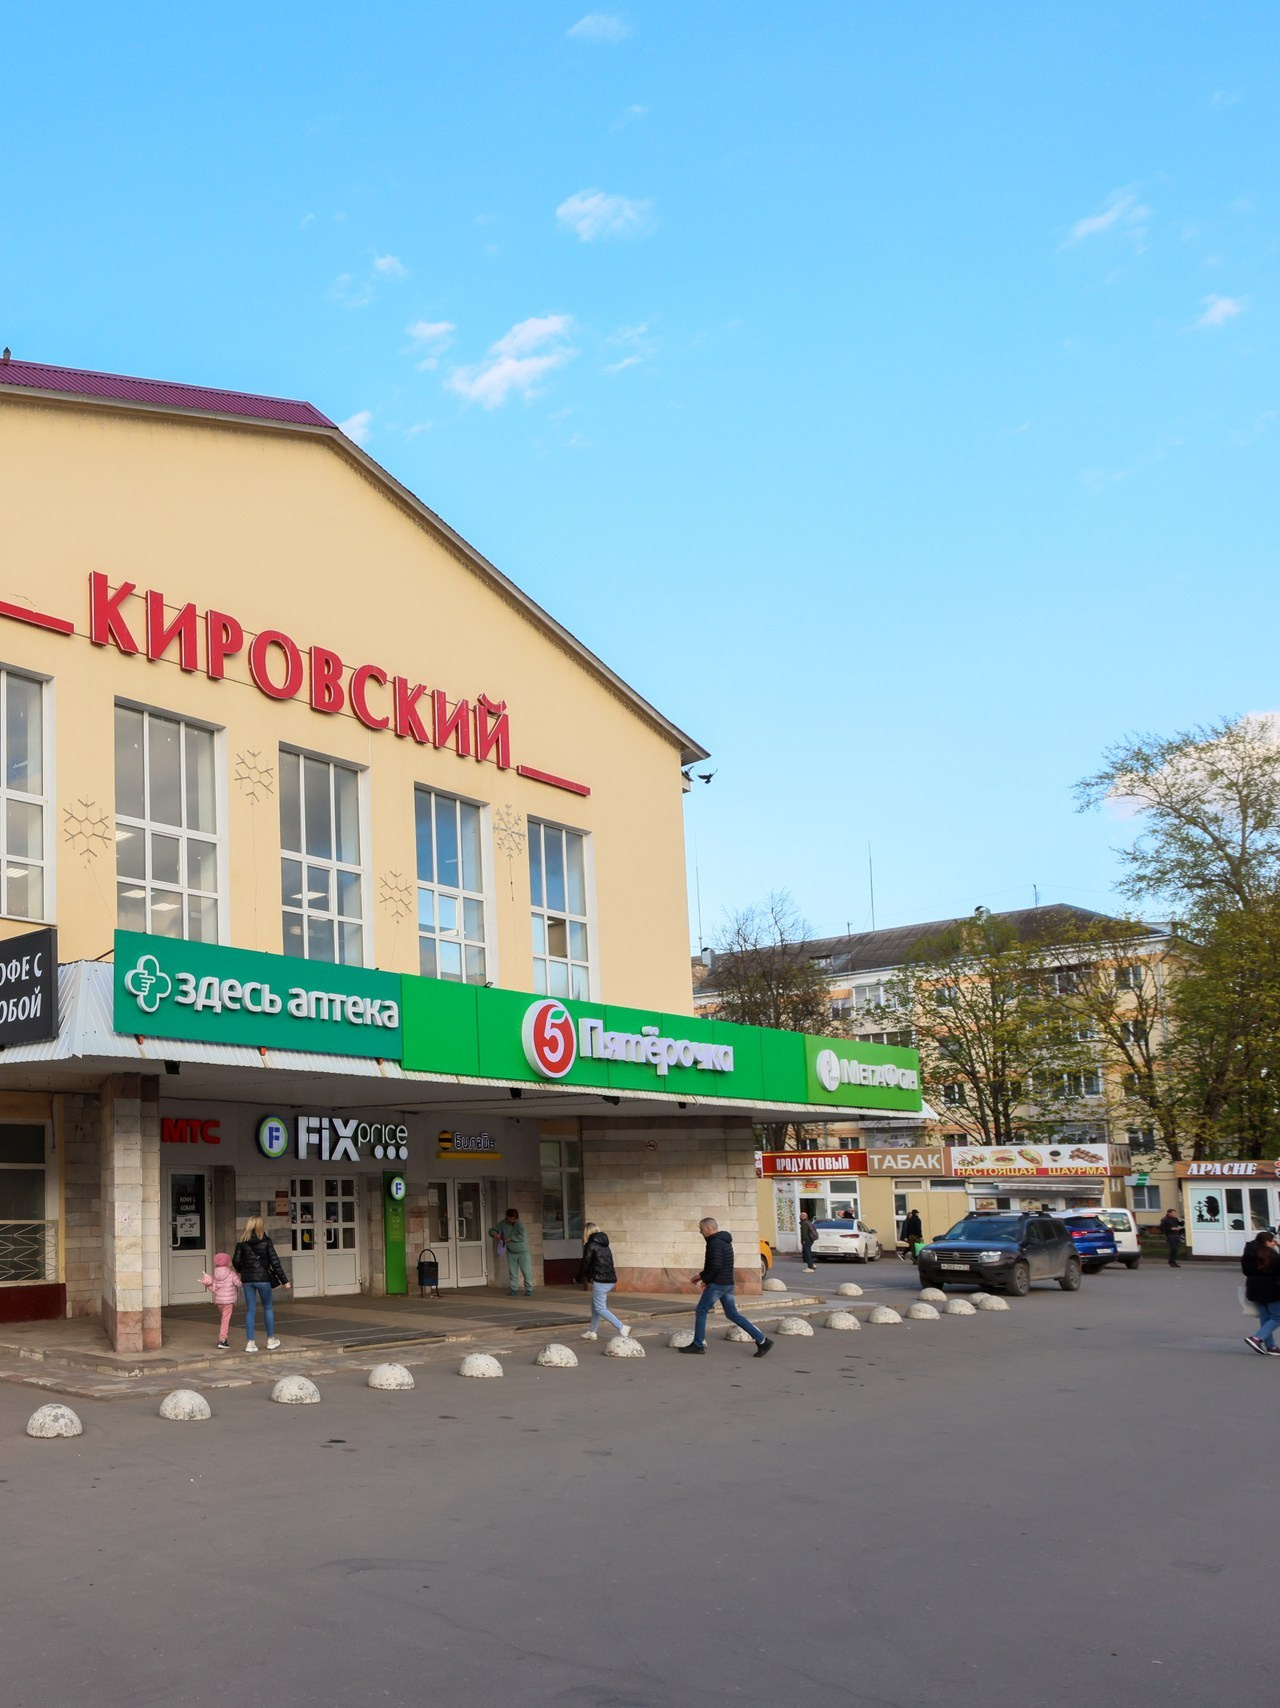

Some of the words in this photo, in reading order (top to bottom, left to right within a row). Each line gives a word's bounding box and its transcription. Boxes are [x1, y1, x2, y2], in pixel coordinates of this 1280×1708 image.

[88, 570, 512, 770] КИРОВСКИЙ
[175, 972, 282, 1014] здесь
[287, 987, 399, 1029] аптека
[578, 1017, 734, 1076] Пятёрочка
[160, 1117, 221, 1145] МТС
[775, 1154, 850, 1172] ПРОДУКТОВЫЙ
[870, 1153, 941, 1170] ТАБАК
[957, 1166, 1037, 1177] НАСТОЯЩАЯ
[1048, 1166, 1107, 1176] ШАУРМА
[1186, 1162, 1258, 1175] APACHE
